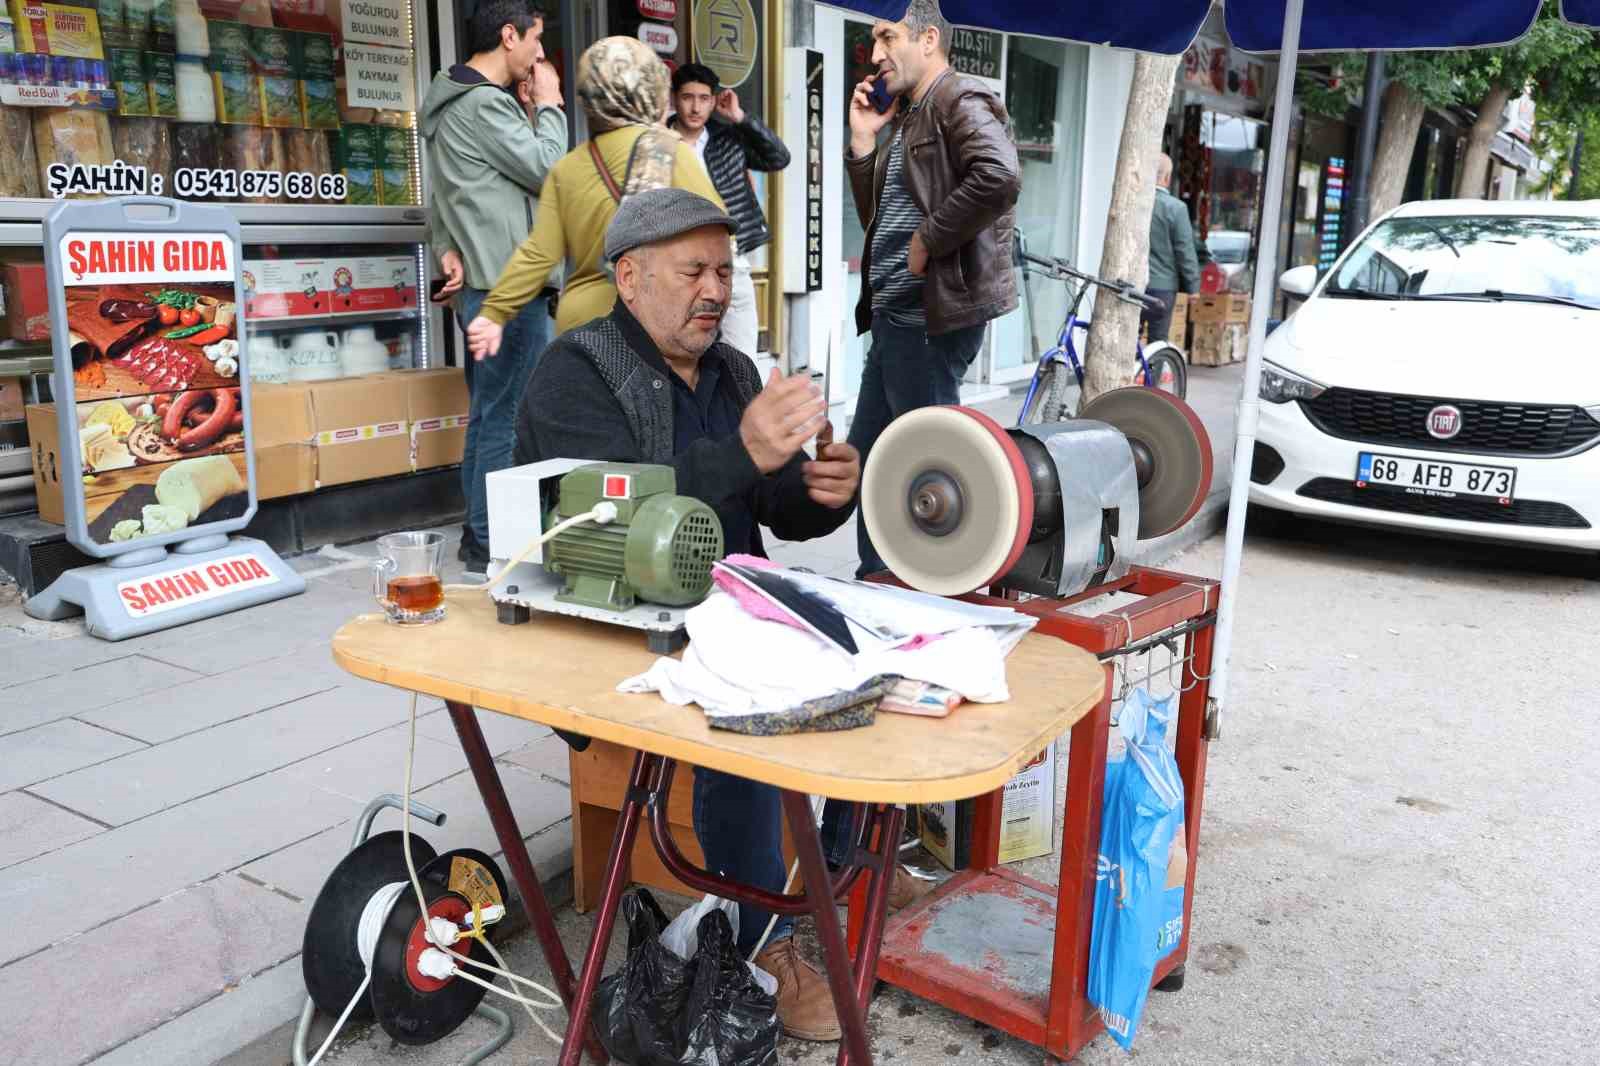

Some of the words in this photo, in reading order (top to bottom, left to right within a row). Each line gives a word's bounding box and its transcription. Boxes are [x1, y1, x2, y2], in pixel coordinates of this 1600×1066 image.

[348, 2, 399, 19] YOĞURDU
[352, 22, 399, 38] BULUNUR
[345, 48, 364, 61] KÖY
[368, 52, 408, 66] TEREYAĞI
[358, 70, 399, 83] KAYMAK
[358, 88, 402, 102] BULUNUR
[49, 162, 145, 195] ŞAHİN
[177, 170, 235, 193] 0541
[243, 172, 280, 194] 875
[288, 174, 313, 195] 68
[320, 175, 345, 196] 68
[163, 240, 227, 271] GIDA
[1434, 415, 1456, 430] FIAT
[1373, 458, 1398, 481] 68
[1412, 463, 1453, 488] AFB
[1467, 469, 1510, 494] 873
[206, 558, 271, 588] GIDA
